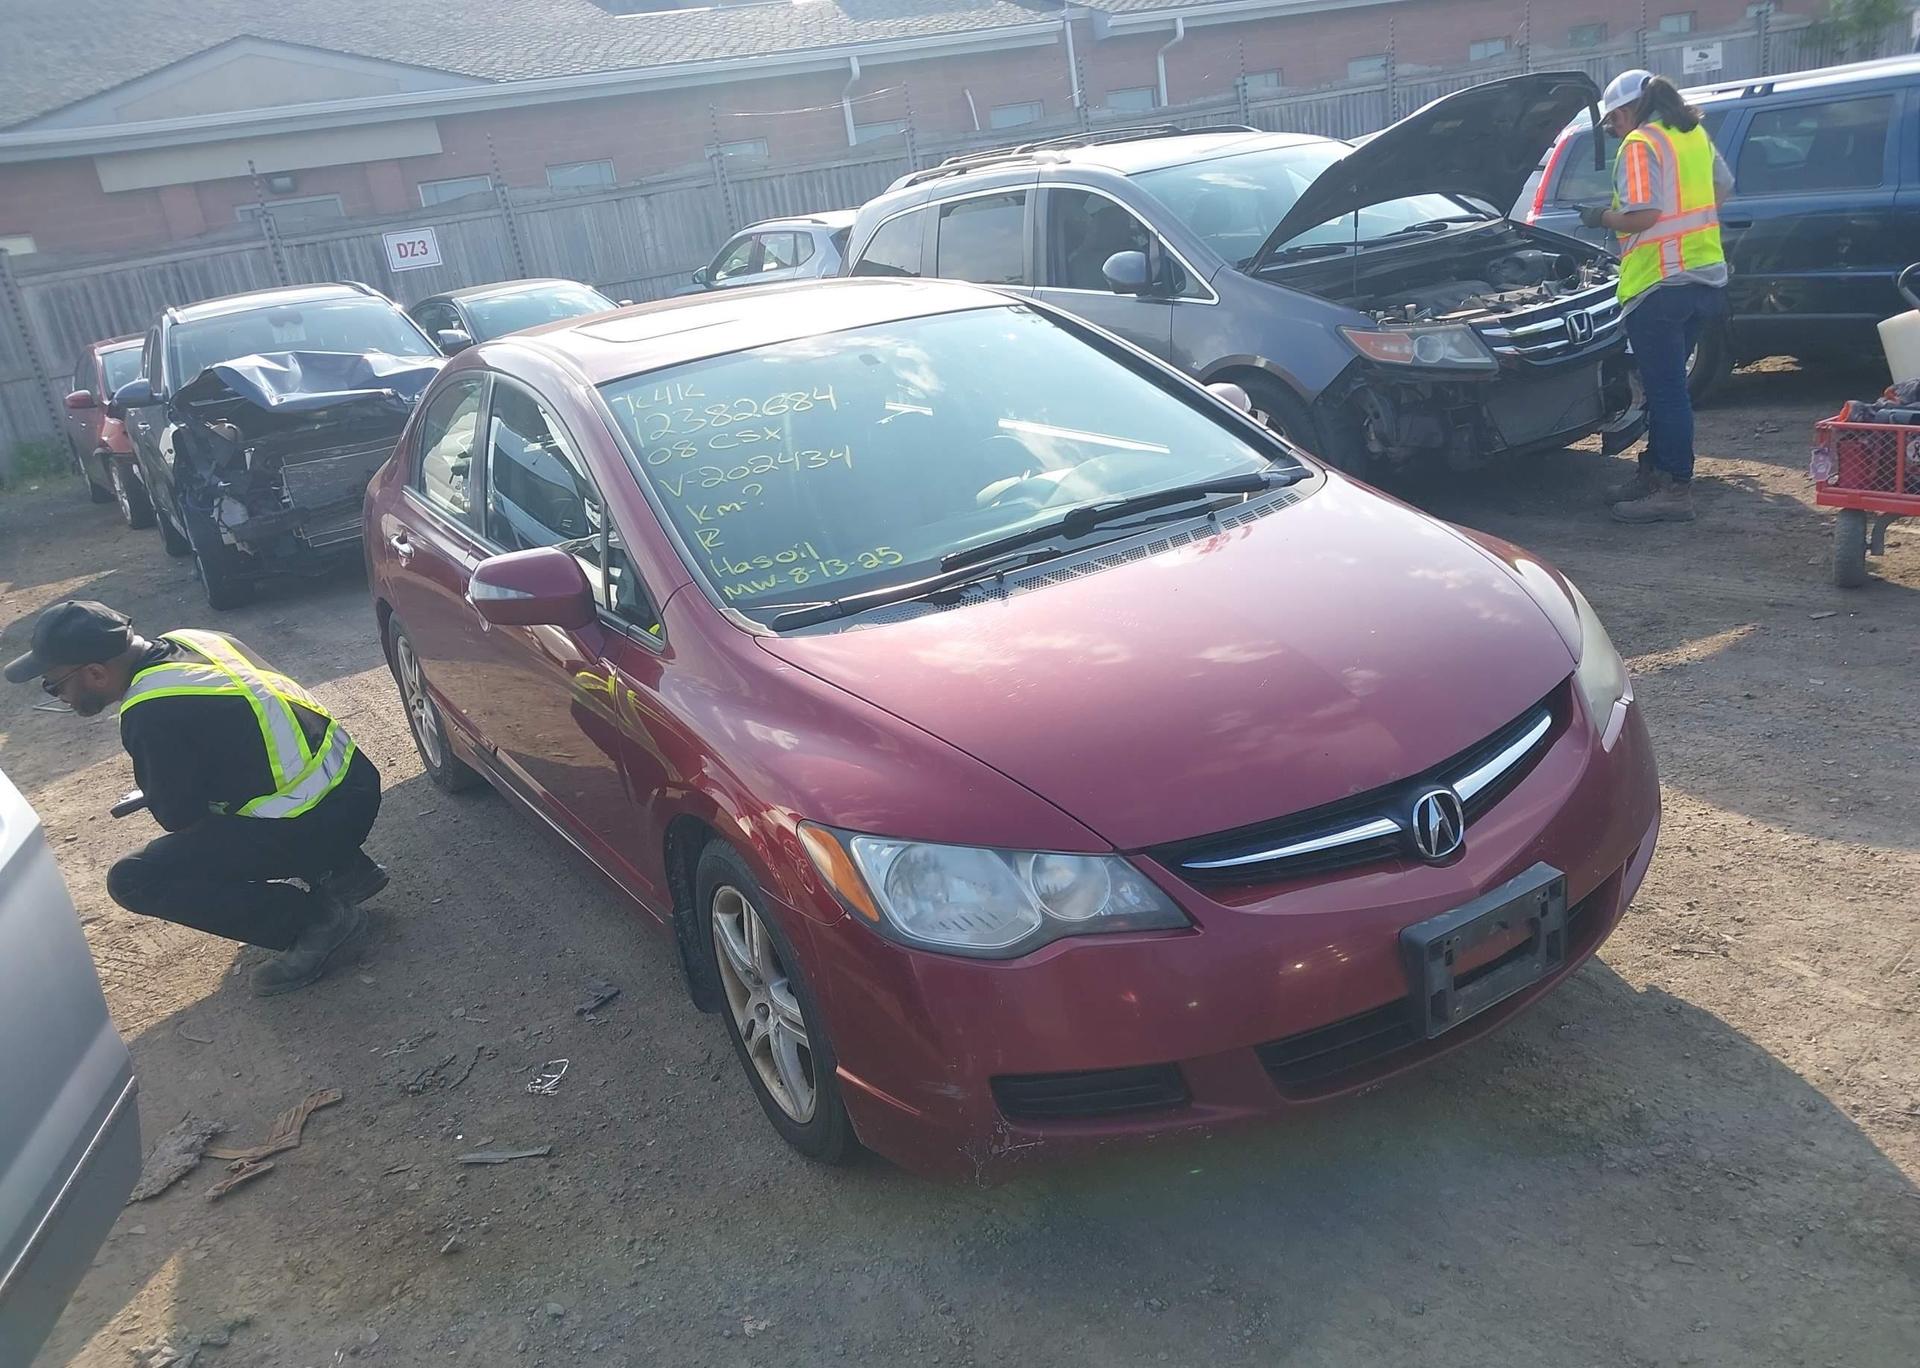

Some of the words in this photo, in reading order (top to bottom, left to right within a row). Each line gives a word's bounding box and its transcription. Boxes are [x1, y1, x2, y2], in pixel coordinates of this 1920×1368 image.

[396, 240, 428, 258] DZ3
[633, 384, 837, 448] 12382684
[647, 440, 698, 465] 08
[708, 426, 783, 449] CSX
[694, 527, 724, 554] R
